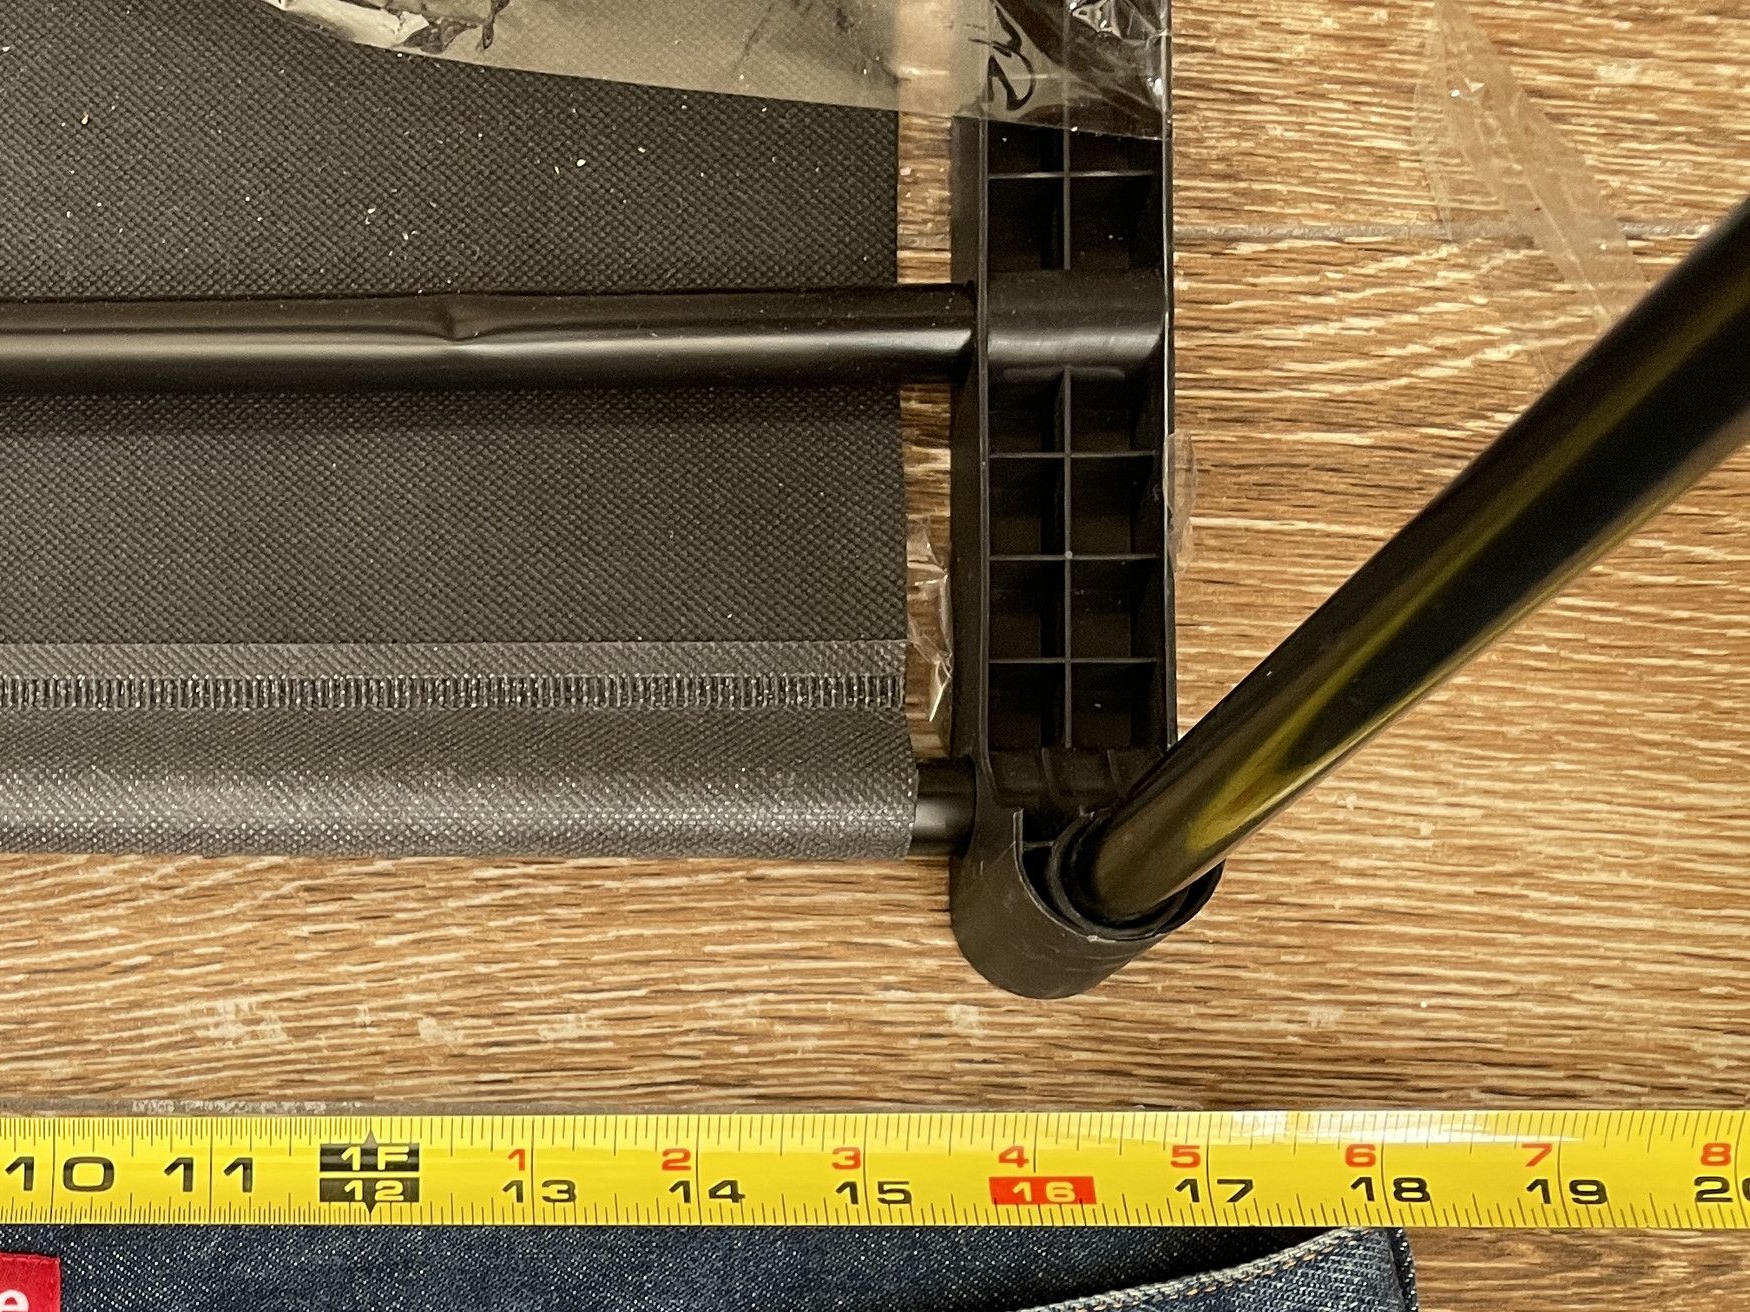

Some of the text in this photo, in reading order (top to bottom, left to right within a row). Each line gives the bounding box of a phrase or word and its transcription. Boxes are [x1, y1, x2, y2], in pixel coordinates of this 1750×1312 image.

[340, 1145, 410, 1172] 1F
[507, 1142, 1733, 1171] 1 2 3 4 5 6 7 8
[6, 1156, 115, 1192] 10
[165, 1156, 254, 1193] 11
[344, 1180, 405, 1202] 12
[501, 1179, 577, 1204] 13
[668, 1179, 746, 1204] 14
[835, 1180, 913, 1205] 15
[1012, 1182, 1076, 1203] 16
[1175, 1178, 1254, 1203] 17
[1350, 1177, 1431, 1204] 18
[1526, 1177, 1608, 1206] 19
